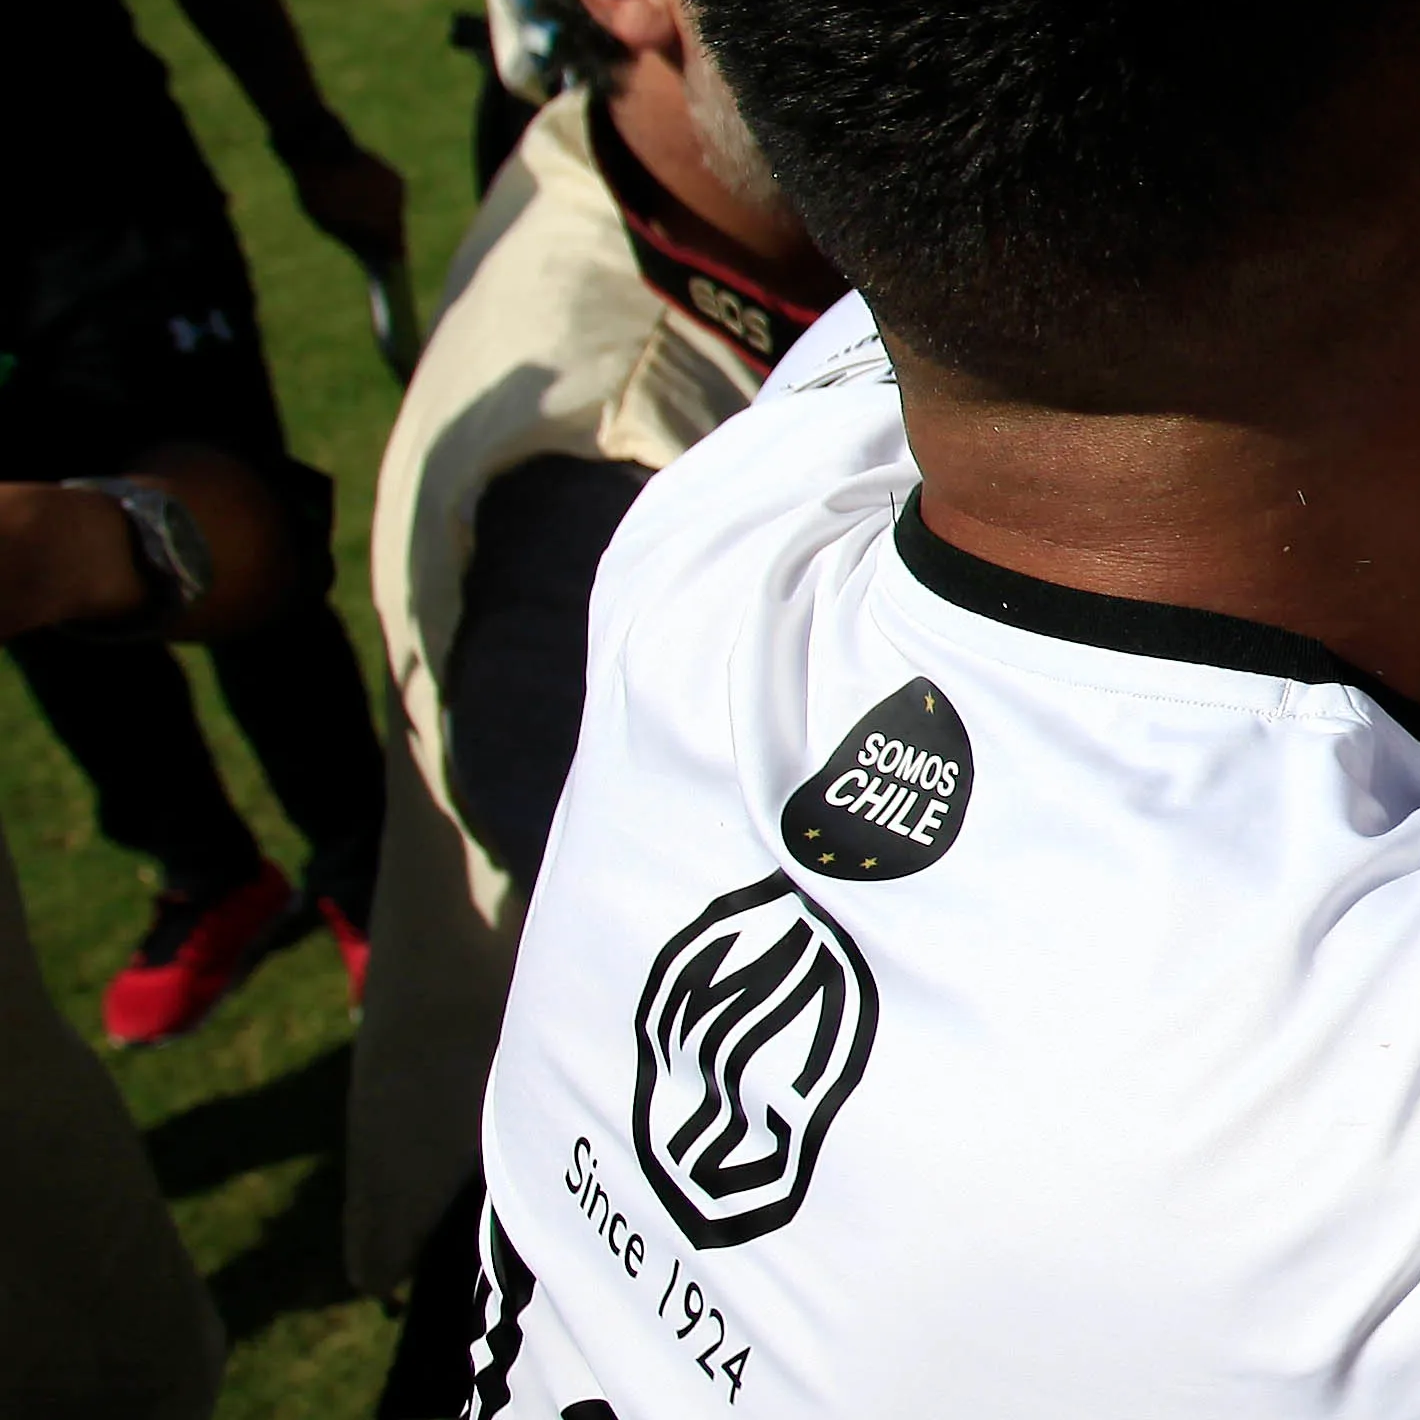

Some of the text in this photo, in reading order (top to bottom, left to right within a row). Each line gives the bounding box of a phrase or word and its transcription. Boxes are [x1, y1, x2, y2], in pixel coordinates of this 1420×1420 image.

[688, 277, 774, 354] EOS
[857, 732, 960, 797] SOMOS
[825, 767, 951, 846] CHILE
[656, 916, 846, 1201] MG
[564, 1136, 753, 1405] Since 1924
